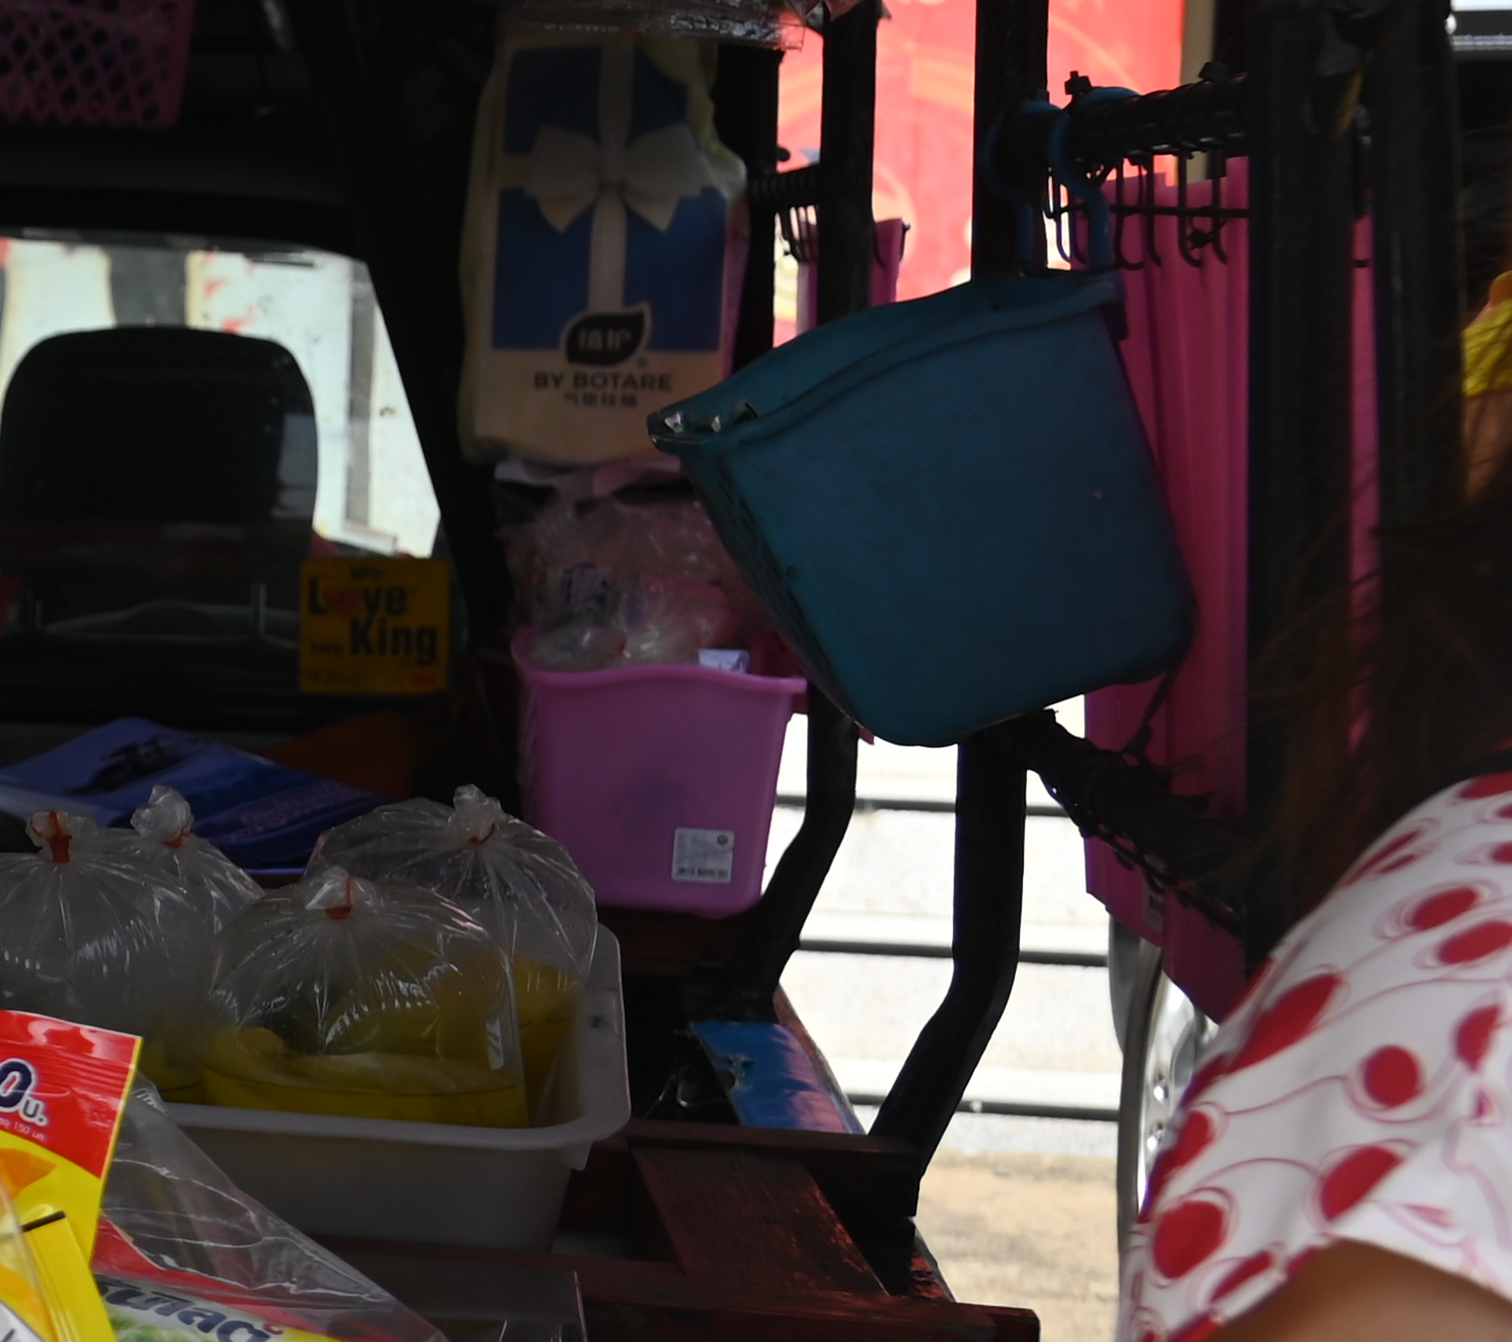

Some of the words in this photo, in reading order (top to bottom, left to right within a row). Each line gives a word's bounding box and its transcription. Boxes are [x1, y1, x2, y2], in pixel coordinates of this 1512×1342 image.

[534, 372, 562, 388] BY
[574, 372, 672, 391] BOTARE
[351, 618, 438, 666] King
[19, 1098, 48, 1126] บ.
